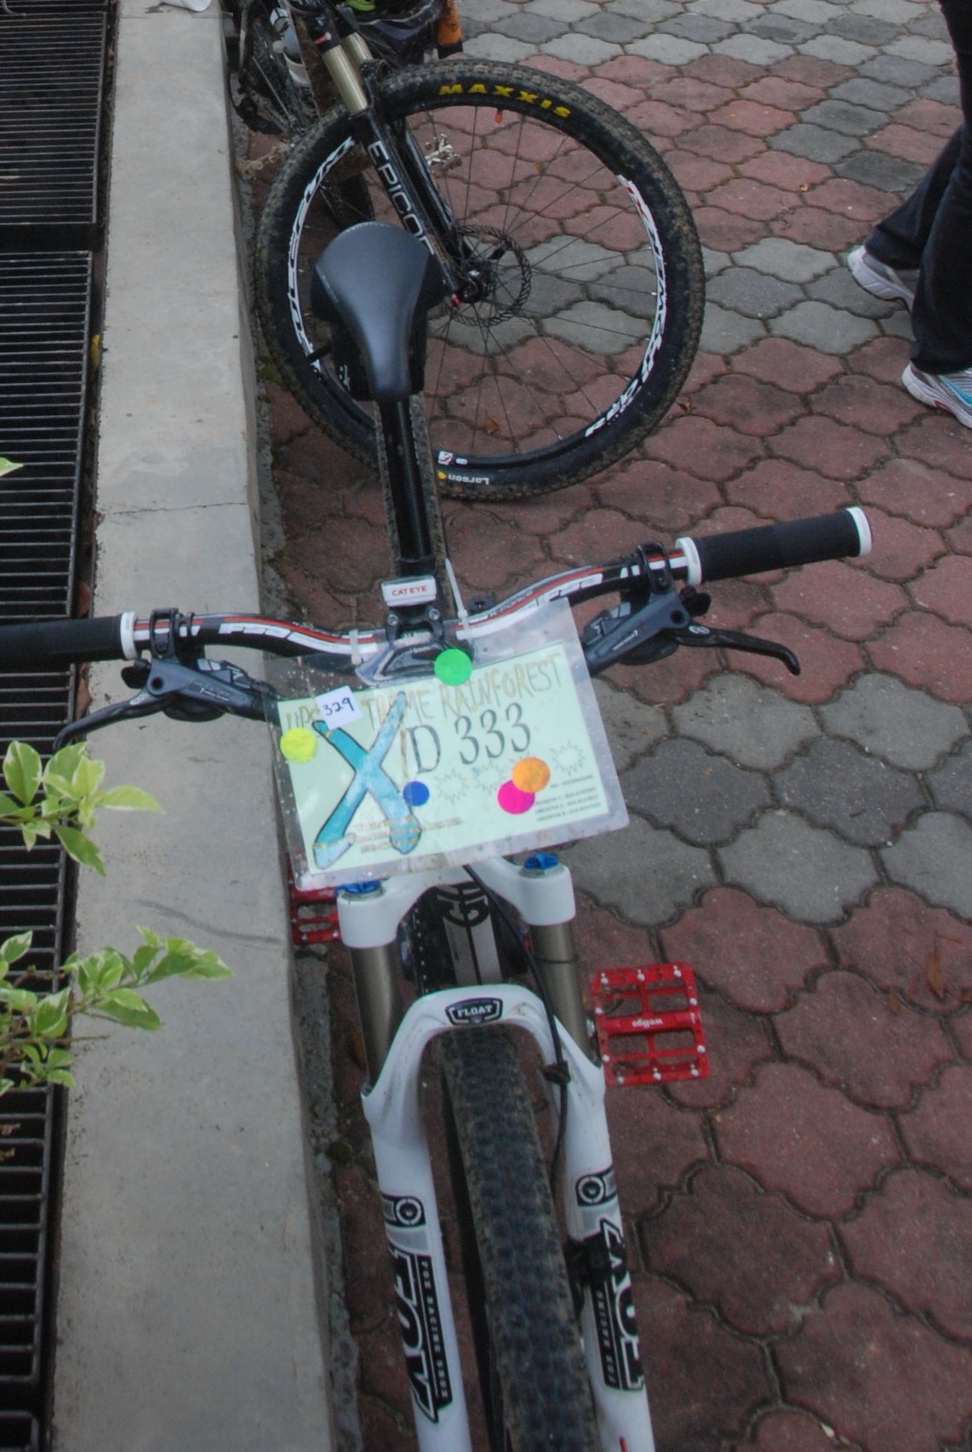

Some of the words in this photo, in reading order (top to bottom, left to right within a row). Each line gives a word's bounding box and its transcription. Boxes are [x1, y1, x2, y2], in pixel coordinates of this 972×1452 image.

[438, 81, 573, 121] MAXXIS
[447, 473, 490, 486] Larson
[439, 653, 563, 719] RAINFOREST
[322, 696, 355, 716] 329
[454, 701, 533, 766] 333
[456, 1004, 493, 1019] FLOAT
[630, 1016, 664, 1029] wellgo
